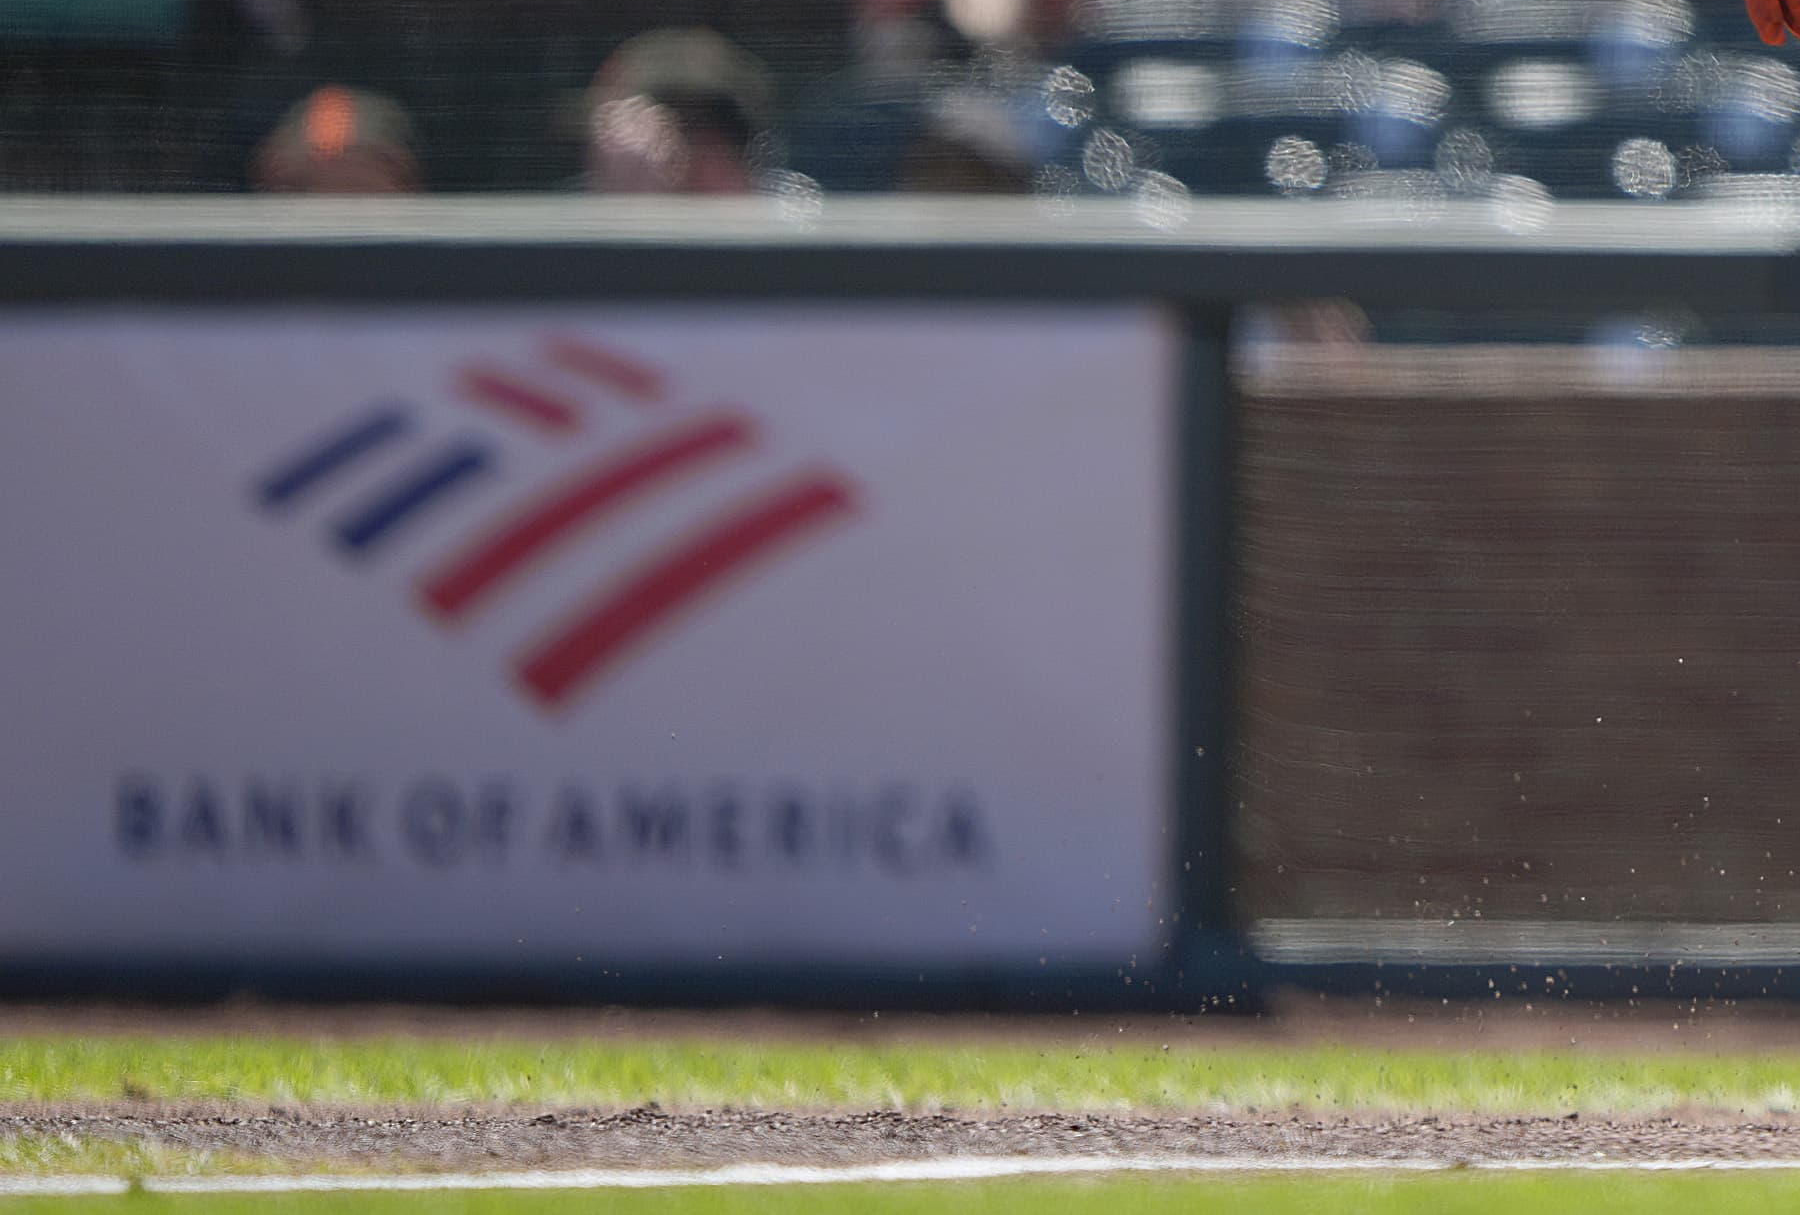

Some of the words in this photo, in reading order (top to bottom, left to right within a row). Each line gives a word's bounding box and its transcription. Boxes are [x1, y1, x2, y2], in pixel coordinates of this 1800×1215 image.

[114, 772, 378, 865] BANK
[400, 774, 516, 869] OF
[547, 777, 996, 875] AMERICA
